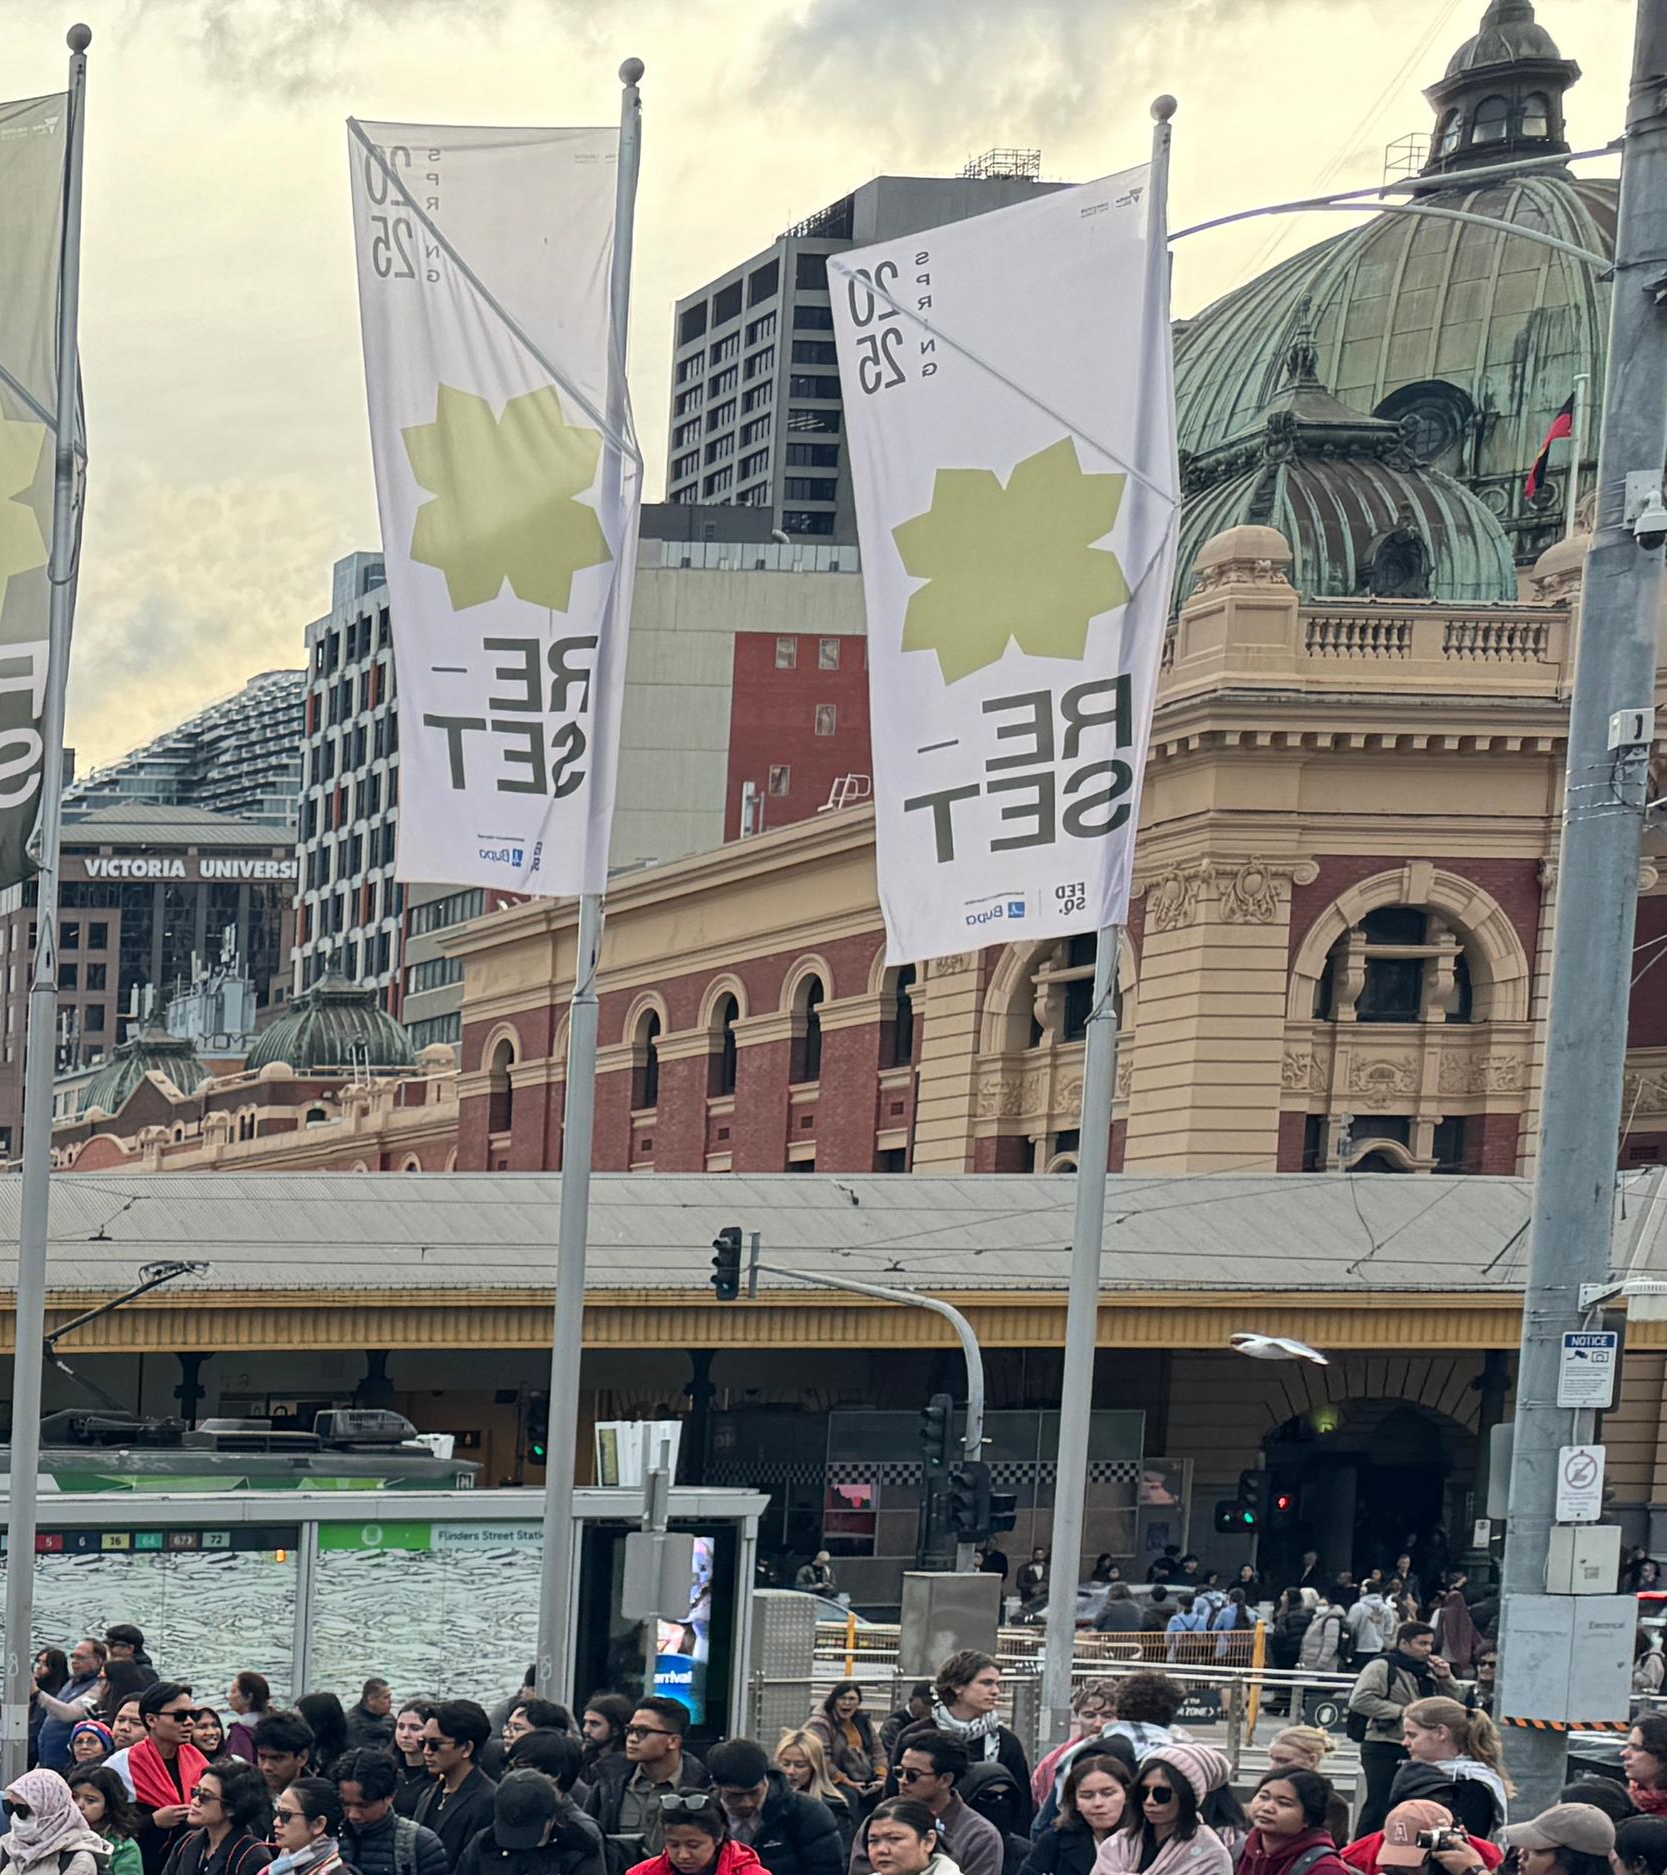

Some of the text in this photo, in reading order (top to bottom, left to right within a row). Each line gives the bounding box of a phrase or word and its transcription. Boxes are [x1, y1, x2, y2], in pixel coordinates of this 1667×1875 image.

[84, 859, 298, 879] VICTORIA UNIVERSI
[1571, 1335, 1608, 1347] NOTICE
[210, 1534, 222, 1544] 72
[439, 1530, 544, 1541] Flinders Street Stati
[79, 1537, 85, 1547] 6
[110, 1536, 121, 1546] 16
